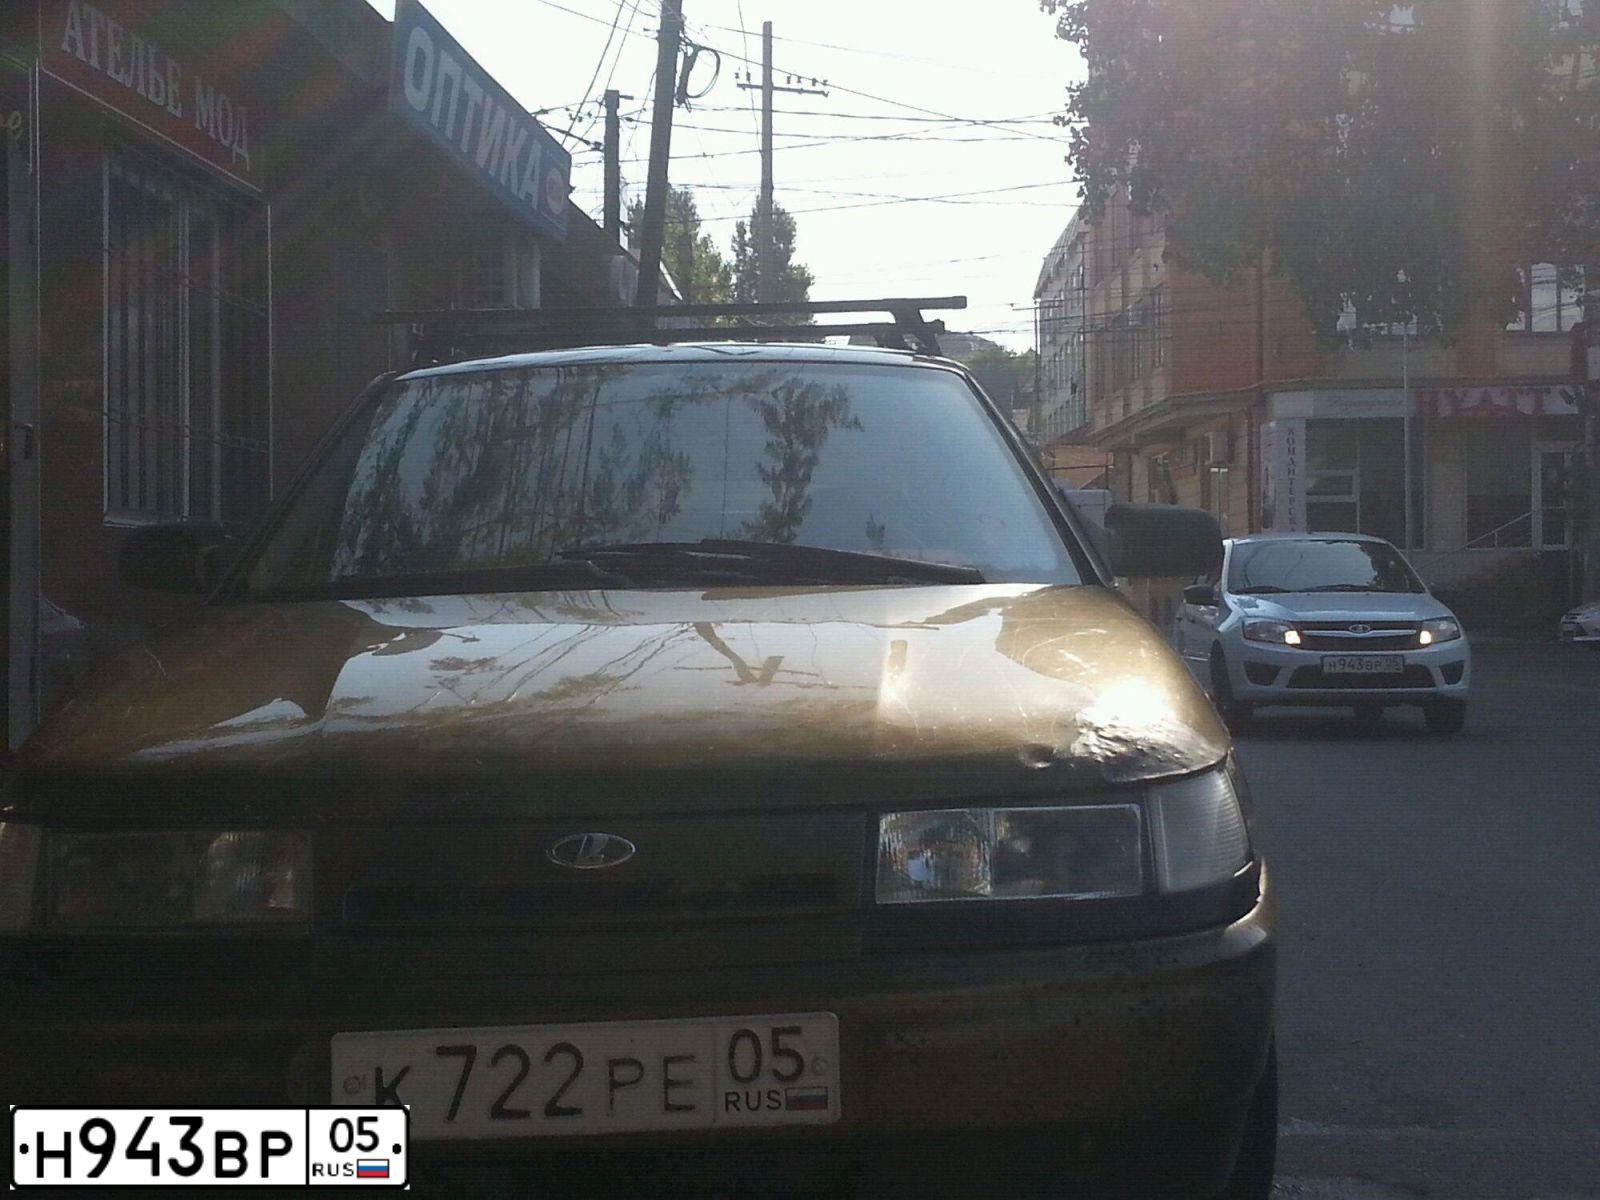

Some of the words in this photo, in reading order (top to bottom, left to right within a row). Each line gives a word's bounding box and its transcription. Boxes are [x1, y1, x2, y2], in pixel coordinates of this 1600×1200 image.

[62, 1, 183, 119] АТЕЛЬЕ
[195, 75, 250, 172] МОД
[404, 26, 542, 210] ОПТИКА
[724, 1087, 782, 1113] RUS
[727, 1025, 805, 1083] 05
